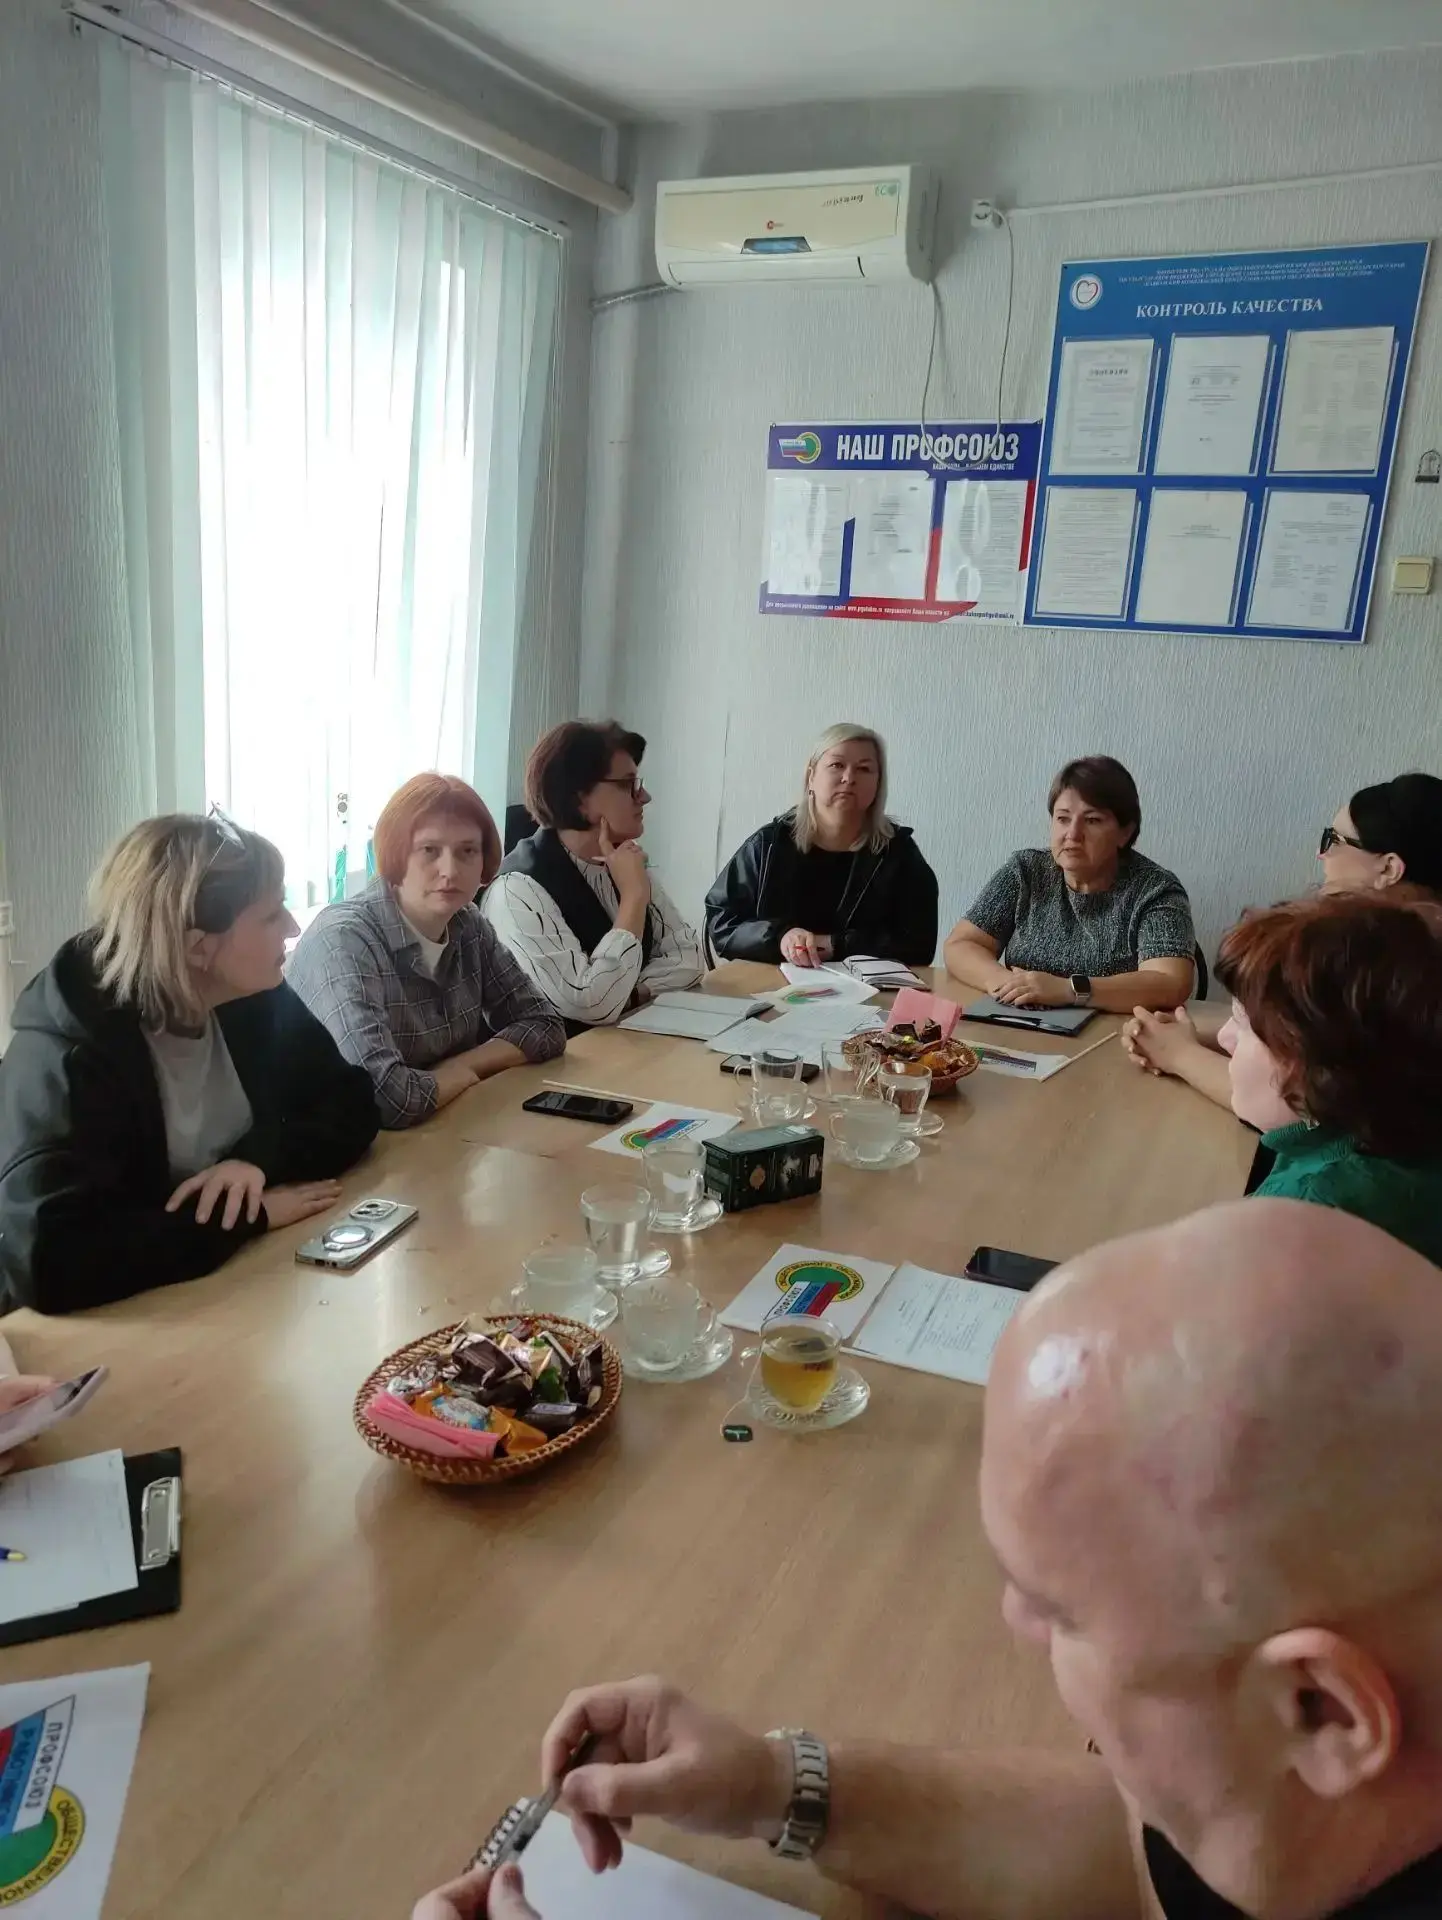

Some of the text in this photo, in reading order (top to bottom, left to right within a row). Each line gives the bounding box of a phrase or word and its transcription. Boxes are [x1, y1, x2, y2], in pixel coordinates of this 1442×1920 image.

[1136, 298, 1324, 318] КОНТРОЛЬ КАЧЕСТВА
[836, 433, 1020, 461] НАШ ПРОФСОЮЗ
[24, 1721, 63, 1810] ПРОФСОЮЗ
